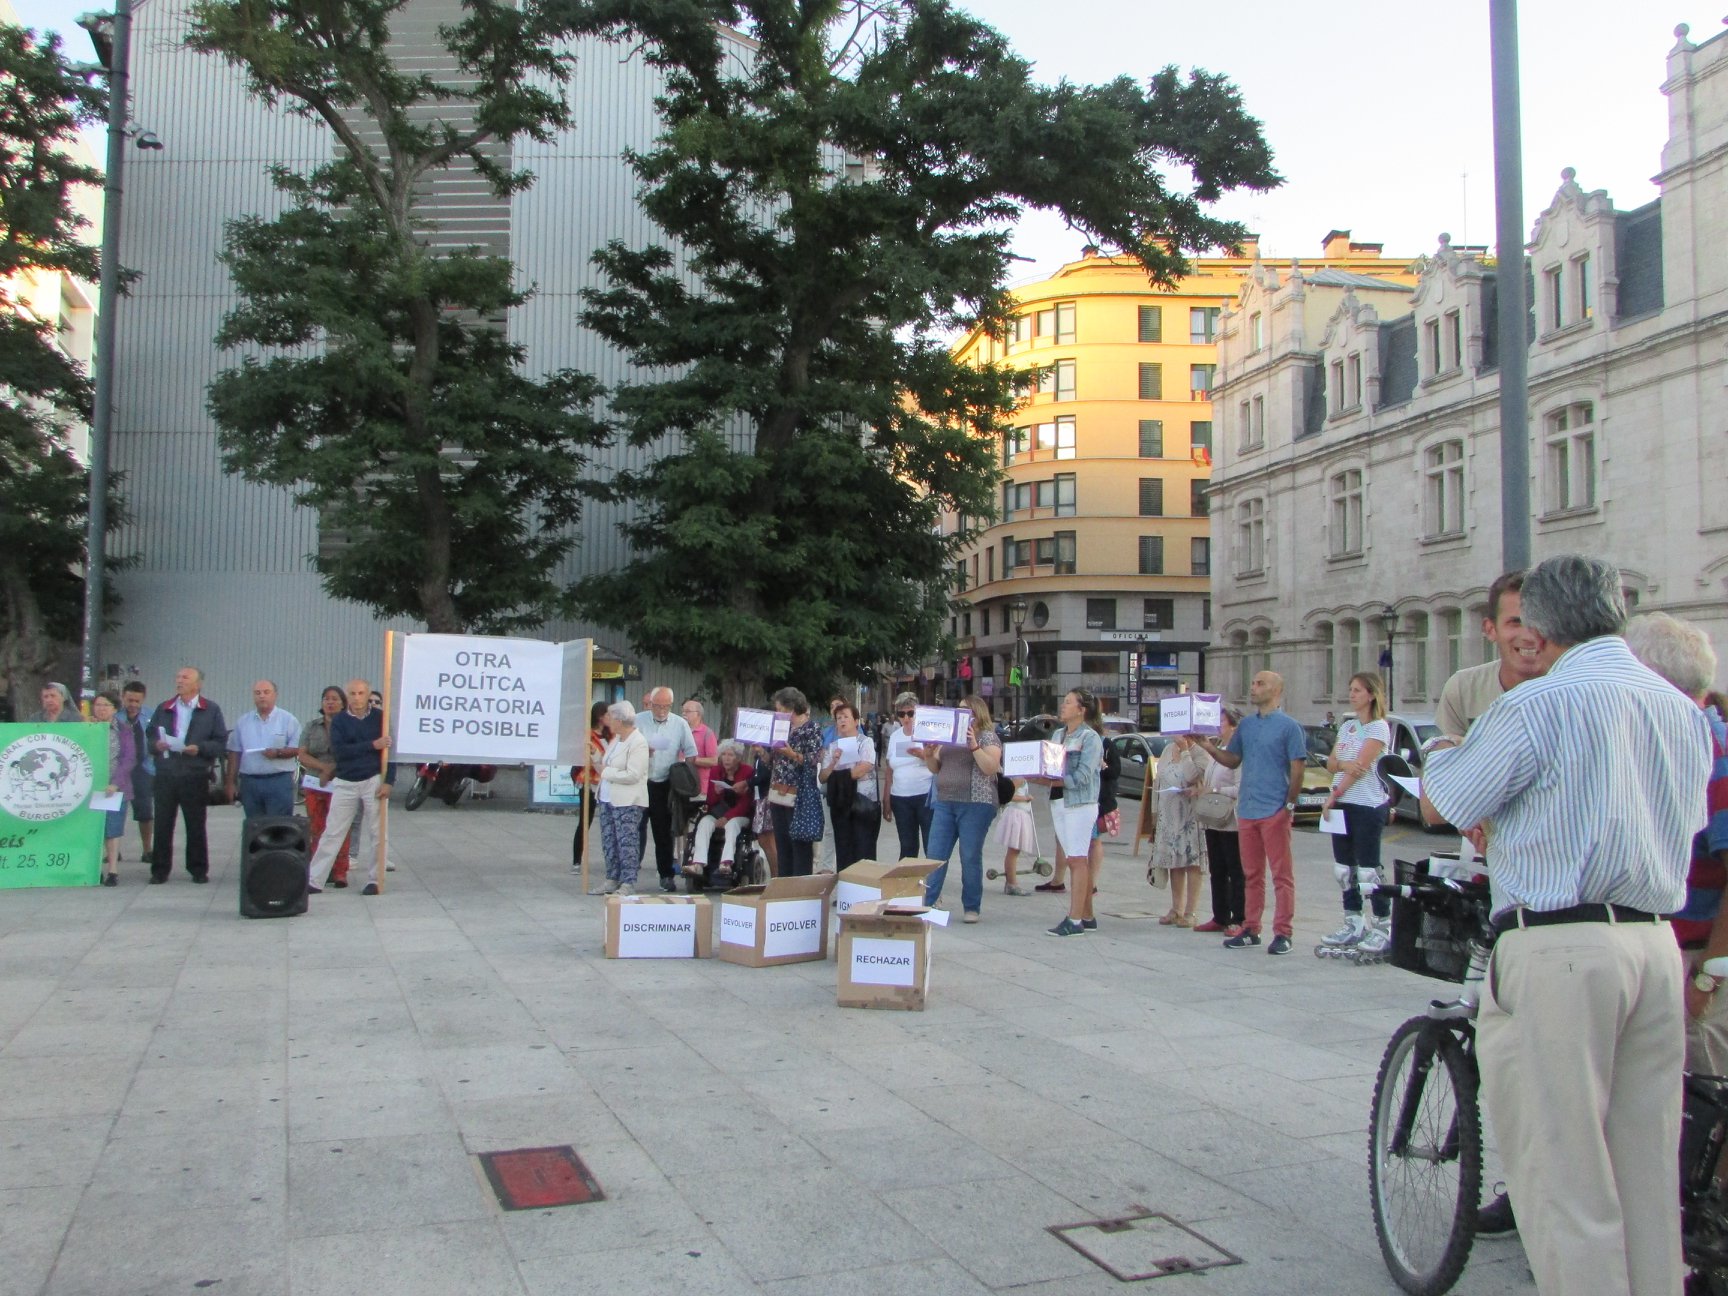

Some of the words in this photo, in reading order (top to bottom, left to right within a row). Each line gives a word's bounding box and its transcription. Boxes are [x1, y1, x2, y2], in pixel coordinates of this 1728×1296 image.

[455, 651, 512, 669] OTRA
[438, 671, 526, 692] POLÍTCA
[415, 694, 545, 716] MIGRATORIA
[418, 717, 445, 734] ES
[452, 719, 539, 738] POSIBLE
[27, 734, 48, 743] CON
[52, 735, 93, 778] INMIGRANTES
[19, 808, 66, 820] BURGOS
[46, 852, 70, 870] 38)
[623, 923, 691, 932] DISCRIMINAR
[723, 917, 753, 929] DEVOLVER
[769, 919, 817, 933] DEVOLVER
[856, 954, 910, 966] RECHAZAR
